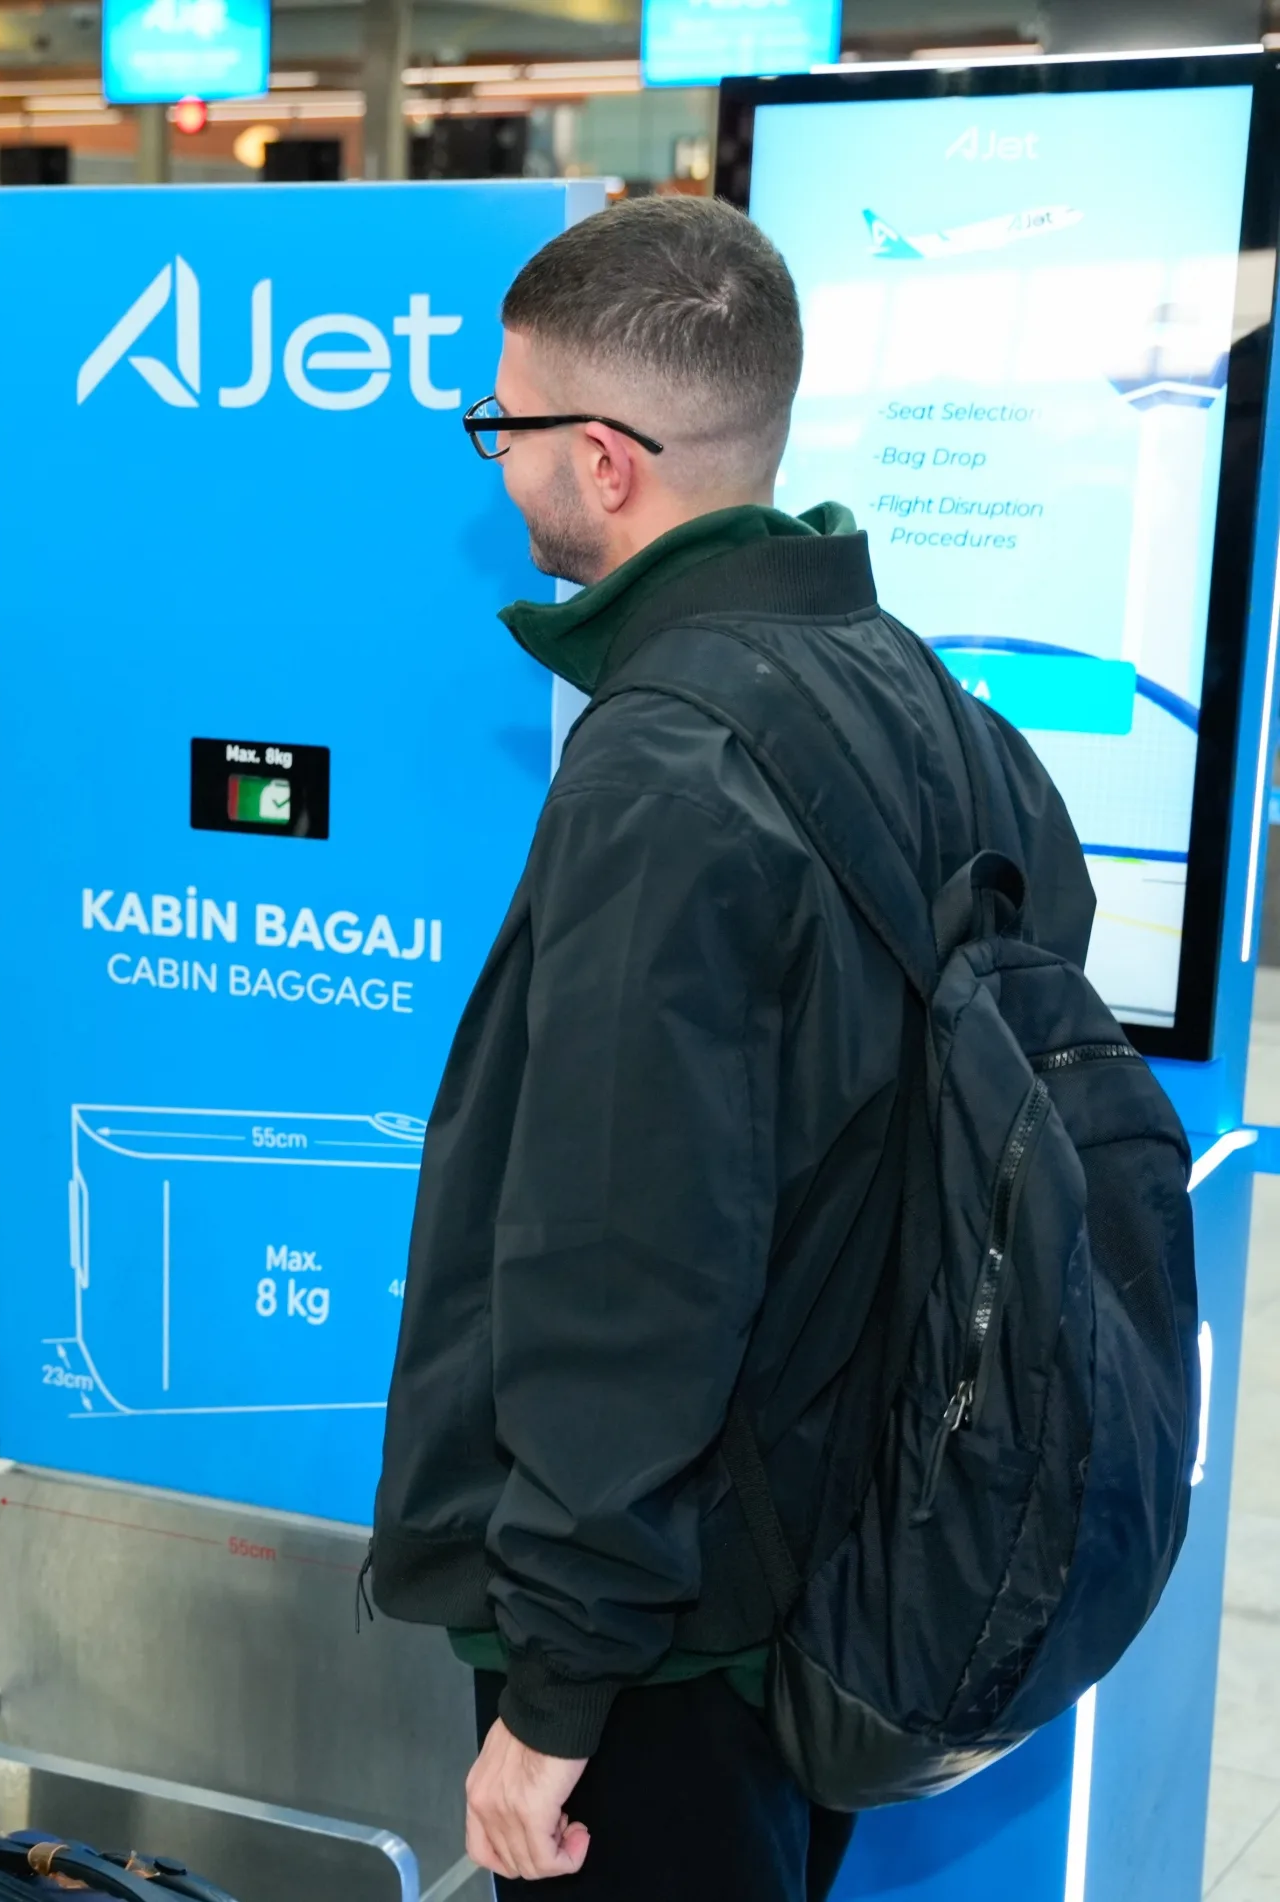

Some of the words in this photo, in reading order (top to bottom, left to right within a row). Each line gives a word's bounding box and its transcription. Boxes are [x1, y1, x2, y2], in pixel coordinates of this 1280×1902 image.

[945, 125, 1040, 162] AJet
[76, 253, 463, 411] AJet
[941, 402, 1042, 423] Selection
[932, 448, 987, 470] Drop
[938, 496, 1044, 519] Disruption
[890, 527, 1018, 550] Procedures
[225, 744, 261, 764] Max.
[264, 747, 293, 769] 8kg
[81, 886, 238, 943] KABİN
[255, 903, 443, 962] BAGAJI
[107, 953, 218, 993] CABIN
[228, 964, 414, 1013] BAGGAGE
[251, 1126, 308, 1150] 55cm
[265, 1244, 323, 1272] Max.
[255, 1278, 278, 1317] 8
[286, 1279, 331, 1325] kg
[41, 1364, 95, 1393] 23cm
[228, 1536, 277, 1562] 55cm
